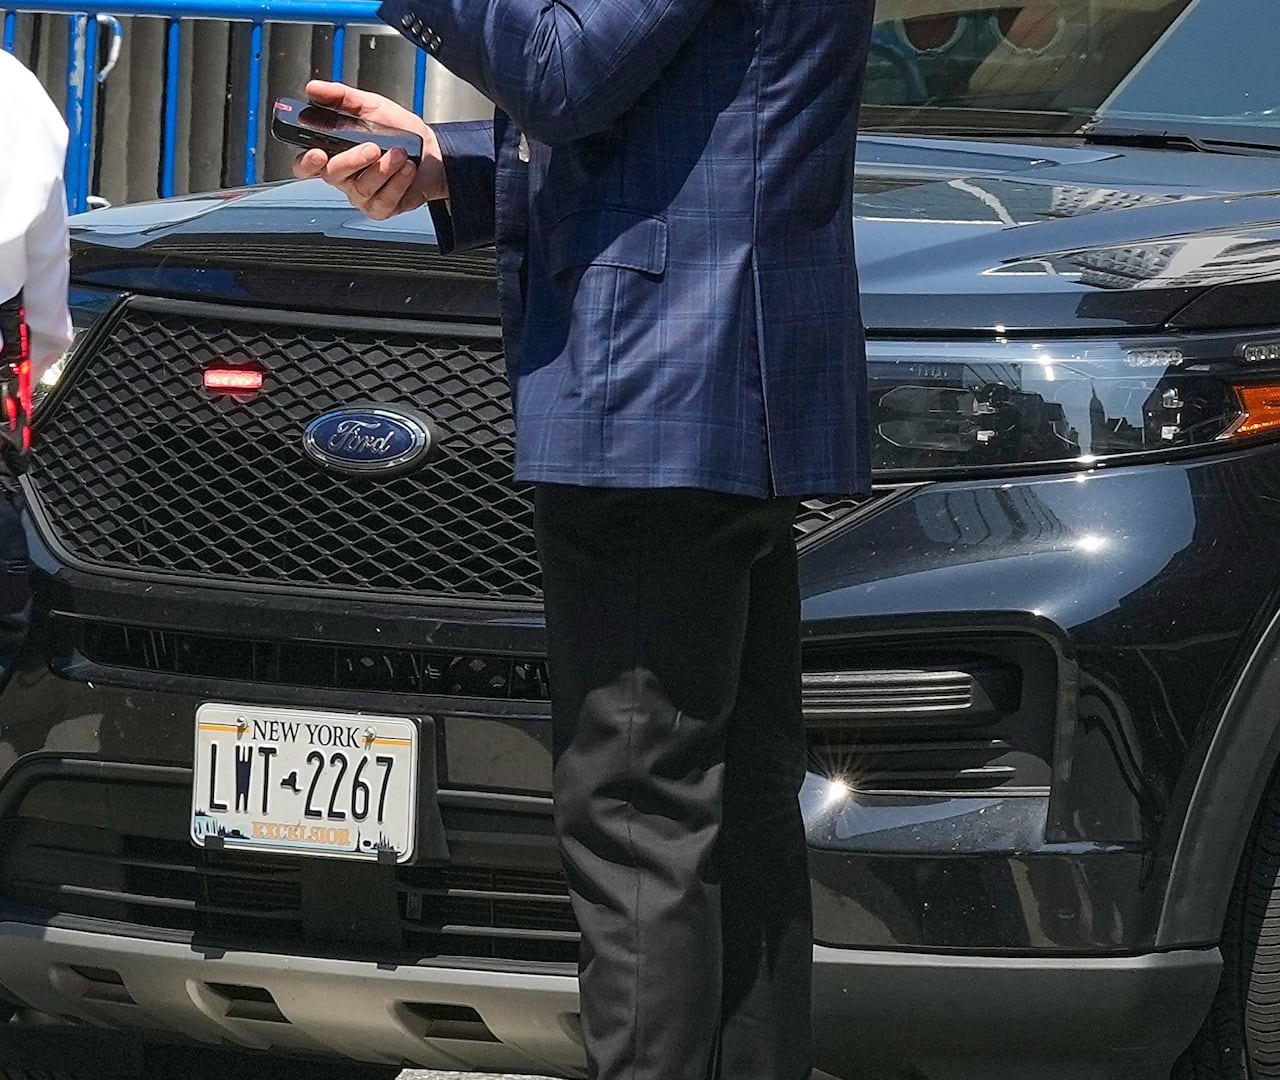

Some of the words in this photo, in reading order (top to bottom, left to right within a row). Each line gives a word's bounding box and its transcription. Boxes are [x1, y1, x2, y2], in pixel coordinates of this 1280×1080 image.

[328, 419, 395, 455] Ford
[251, 719, 301, 745] NEW
[302, 723, 361, 749] YORK
[209, 742, 278, 816] LWT
[303, 749, 394, 824] 2267
[251, 820, 352, 847] EXCELSIOR
